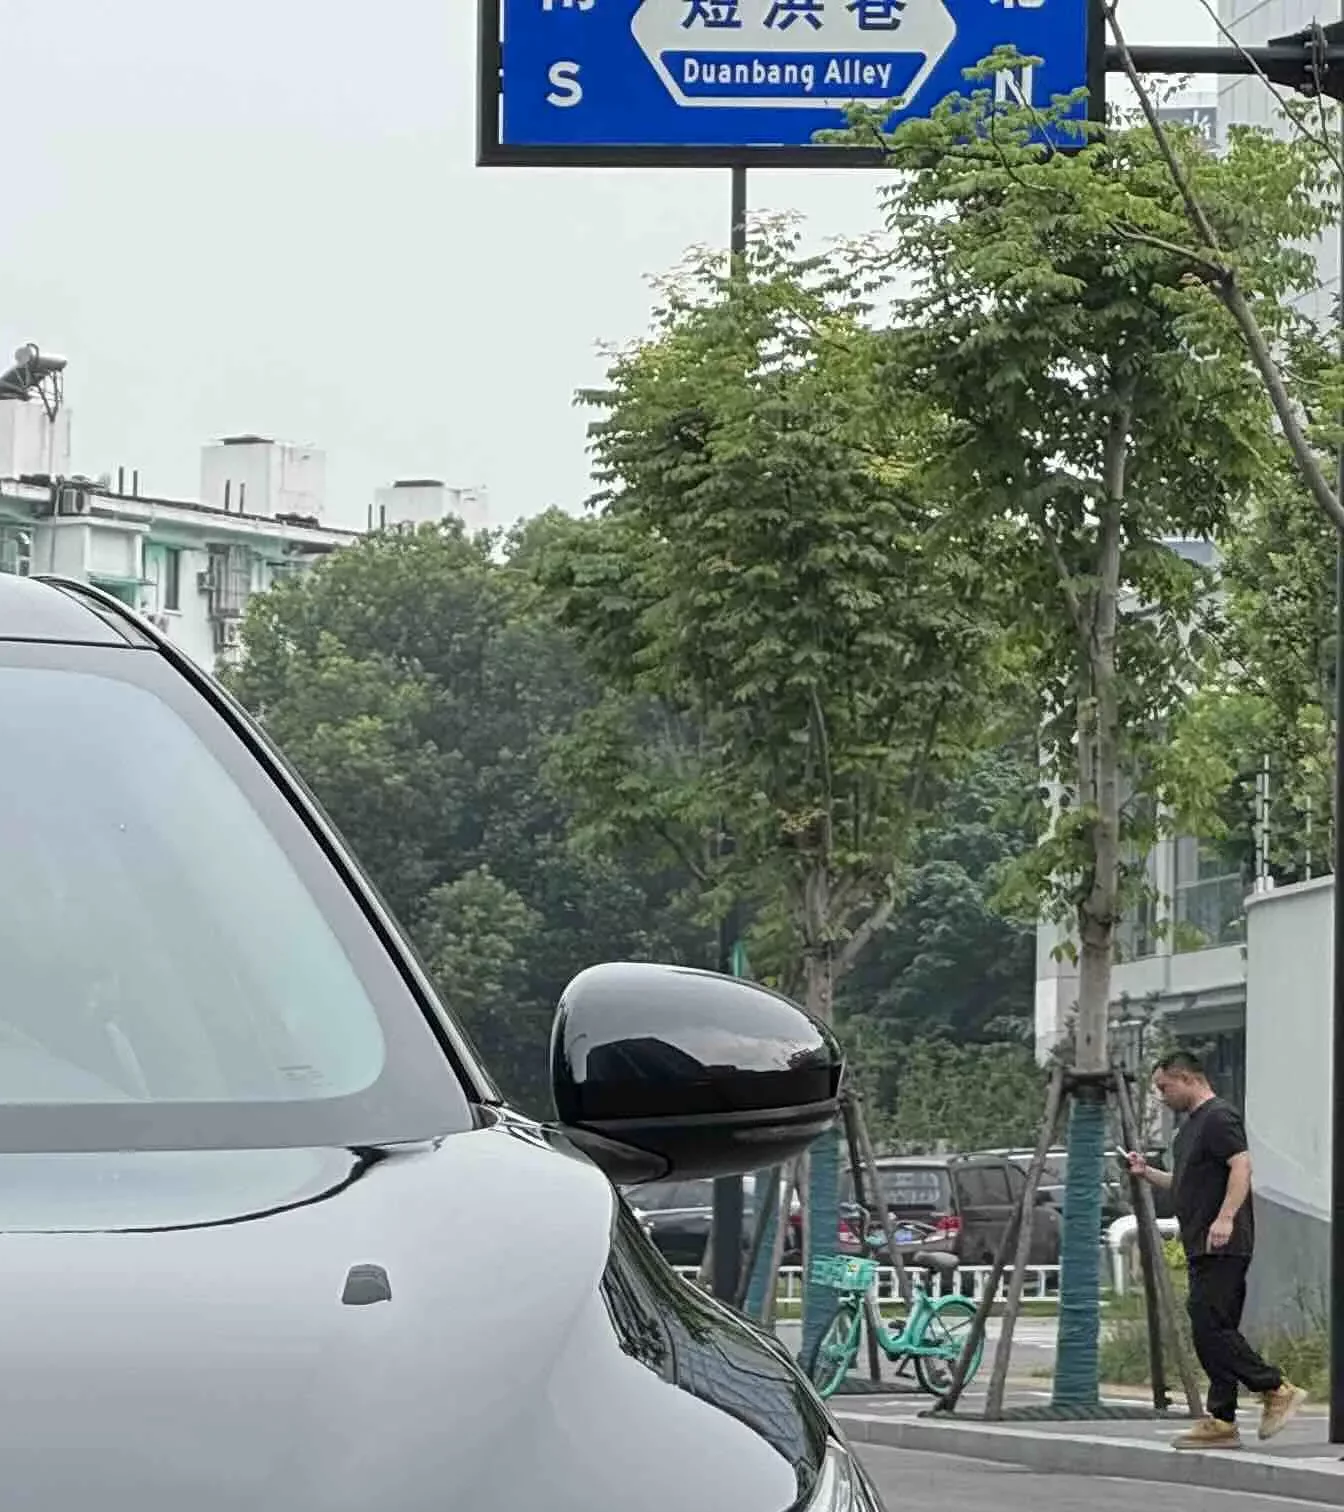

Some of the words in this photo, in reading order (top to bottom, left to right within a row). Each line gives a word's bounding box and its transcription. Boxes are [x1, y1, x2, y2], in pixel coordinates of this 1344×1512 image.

[545, 60, 584, 108] S
[683, 57, 815, 93] Duanbang
[823, 58, 893, 89] Alley
[994, 62, 1033, 108] N
